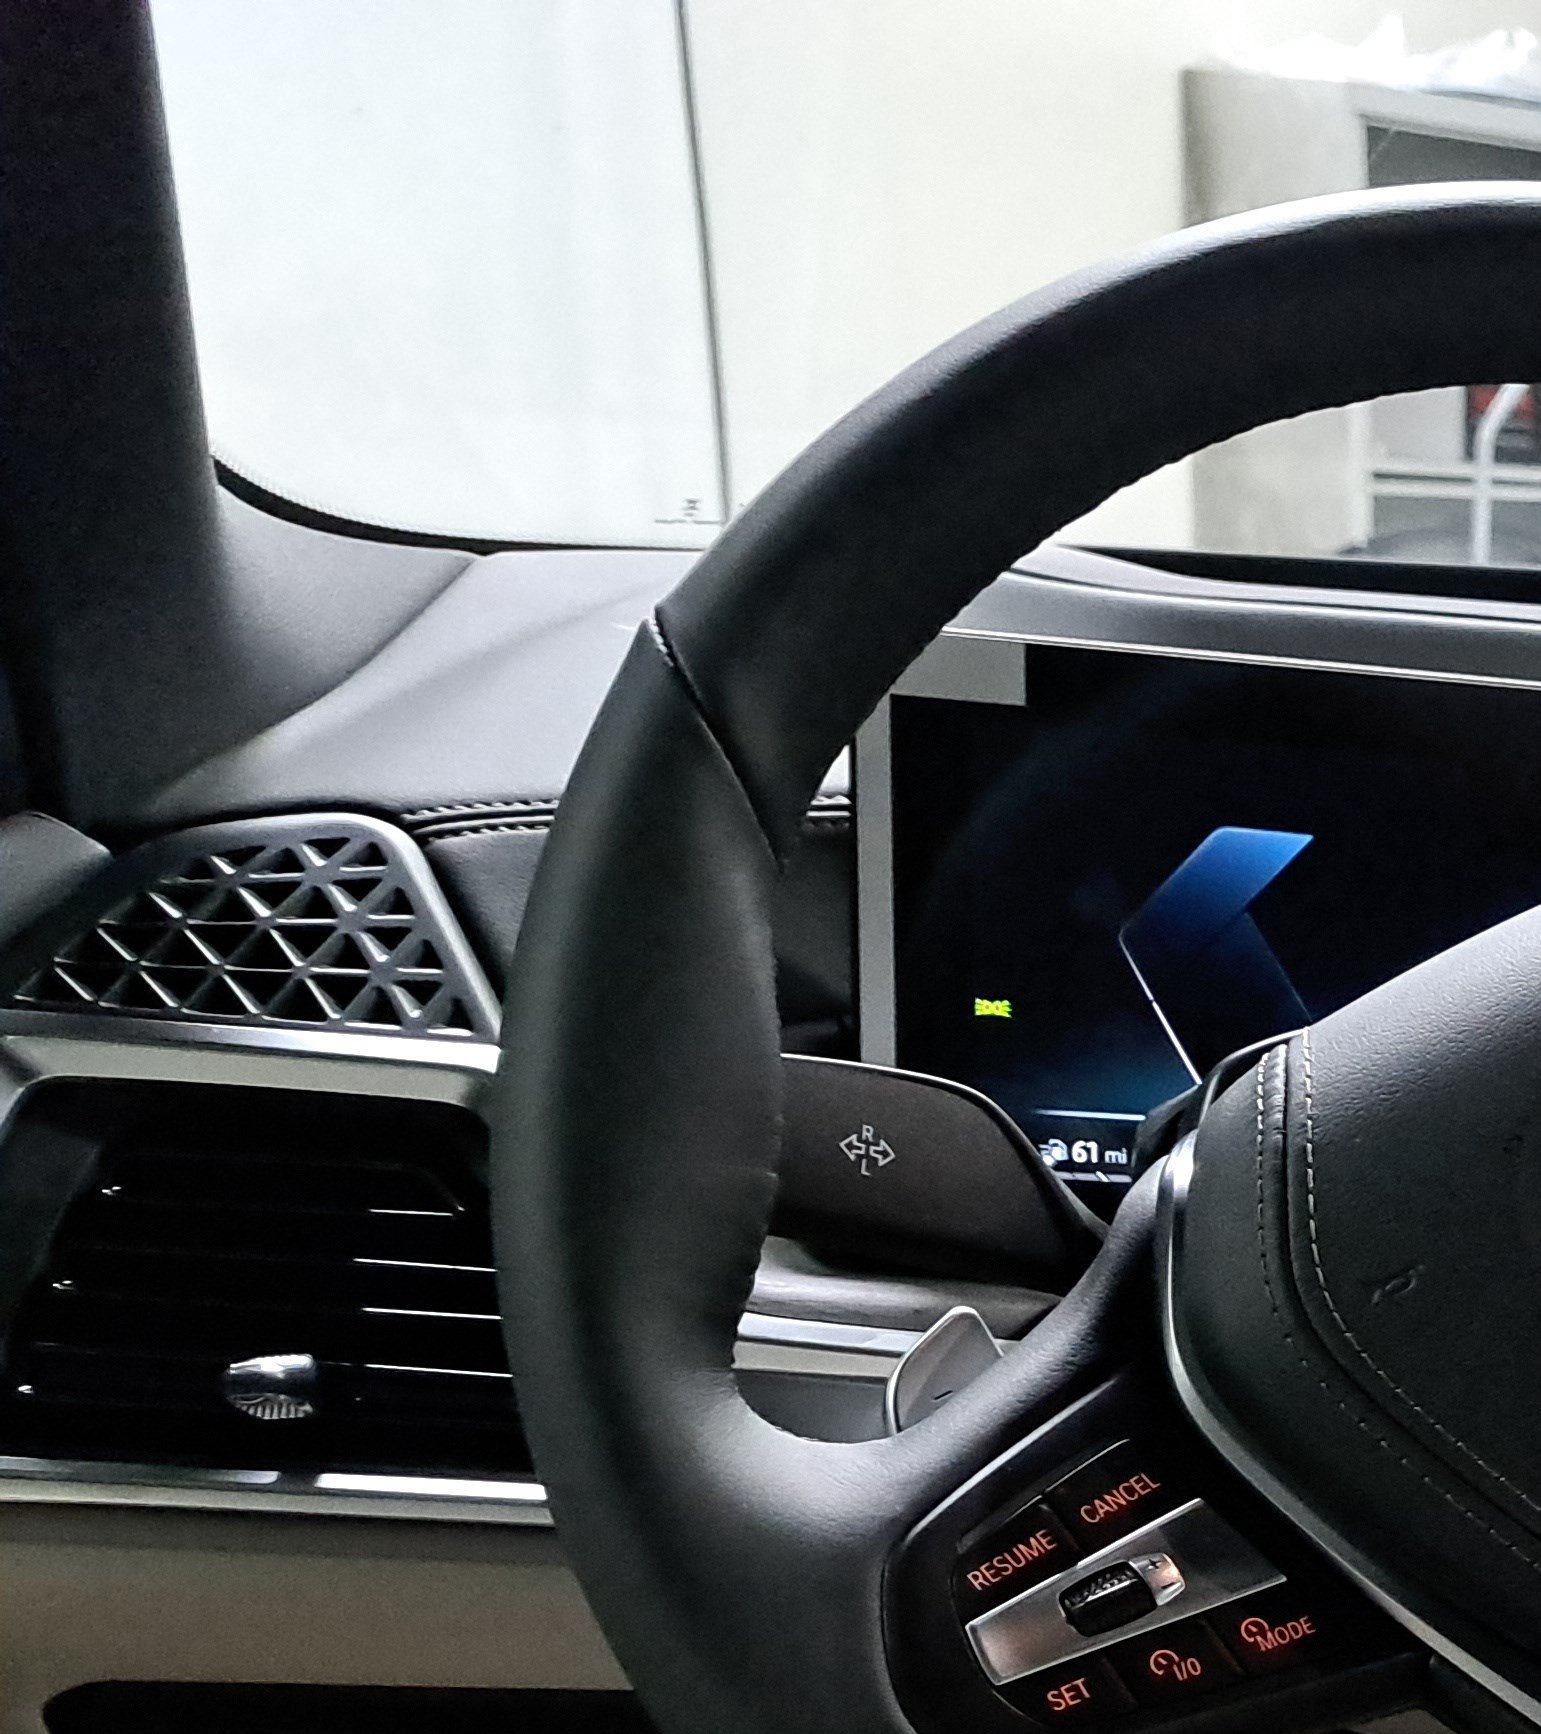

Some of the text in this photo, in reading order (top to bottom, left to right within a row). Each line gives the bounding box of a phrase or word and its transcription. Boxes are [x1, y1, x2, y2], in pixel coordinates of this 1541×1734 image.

[862, 1124, 874, 1142] R
[1072, 1141, 1128, 1164] 61 mi
[1080, 1472, 1162, 1524] CANCEL
[966, 1529, 1058, 1593] RESUME
[1256, 1614, 1317, 1653] MODE
[1046, 1676, 1091, 1712] SET
